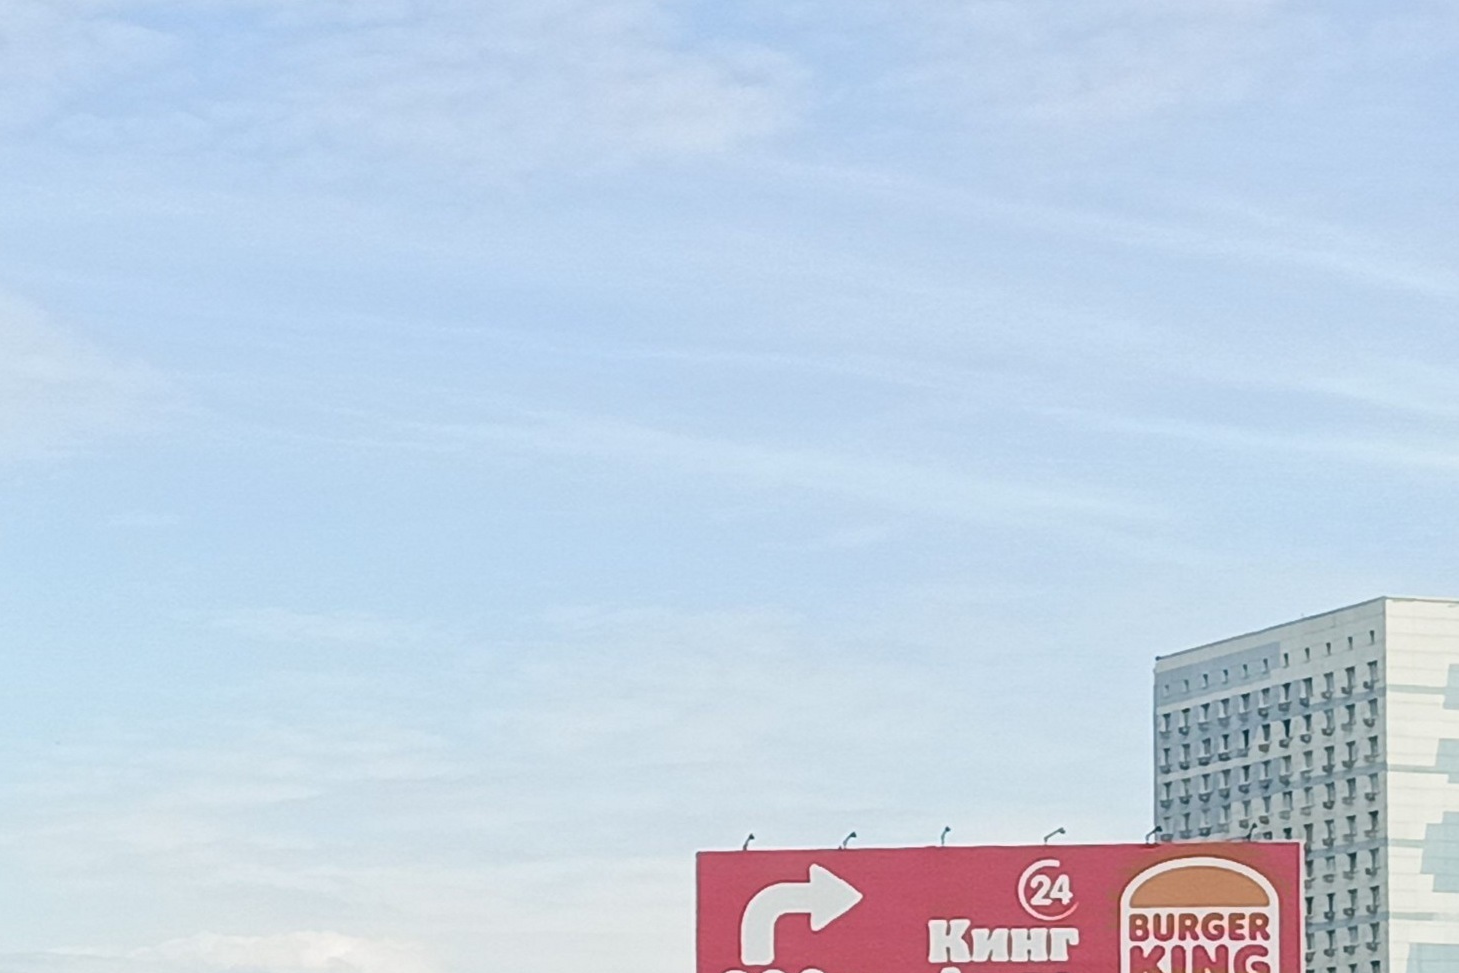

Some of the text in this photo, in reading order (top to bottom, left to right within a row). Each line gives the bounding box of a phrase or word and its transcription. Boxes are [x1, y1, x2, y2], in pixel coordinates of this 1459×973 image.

[1030, 874, 1074, 906] 24
[928, 918, 1080, 963] Кинг
[1129, 912, 1271, 942] BURGER
